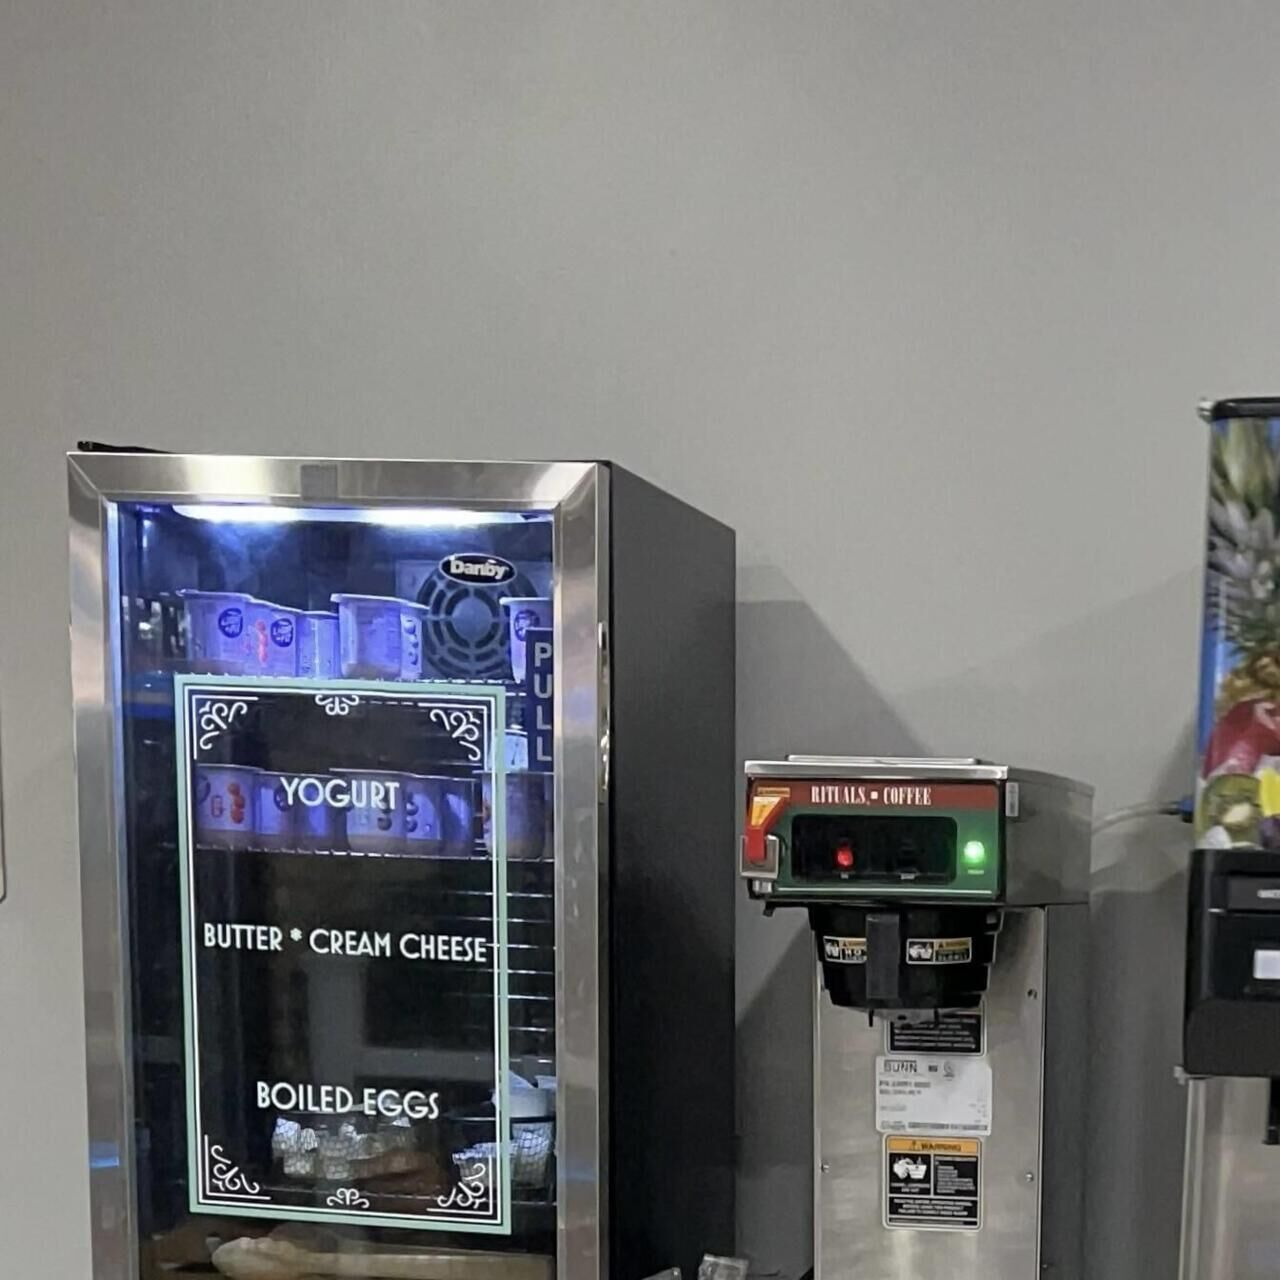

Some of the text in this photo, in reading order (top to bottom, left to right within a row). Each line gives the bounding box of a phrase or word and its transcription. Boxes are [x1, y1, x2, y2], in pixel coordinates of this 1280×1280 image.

[450, 556, 509, 579] Danby
[280, 776, 400, 811] YOGURT
[883, 786, 932, 806] COFFEE
[203, 922, 488, 964] BUTTER CREAM CHEESE
[256, 1080, 440, 1120] BOILED EGGS
